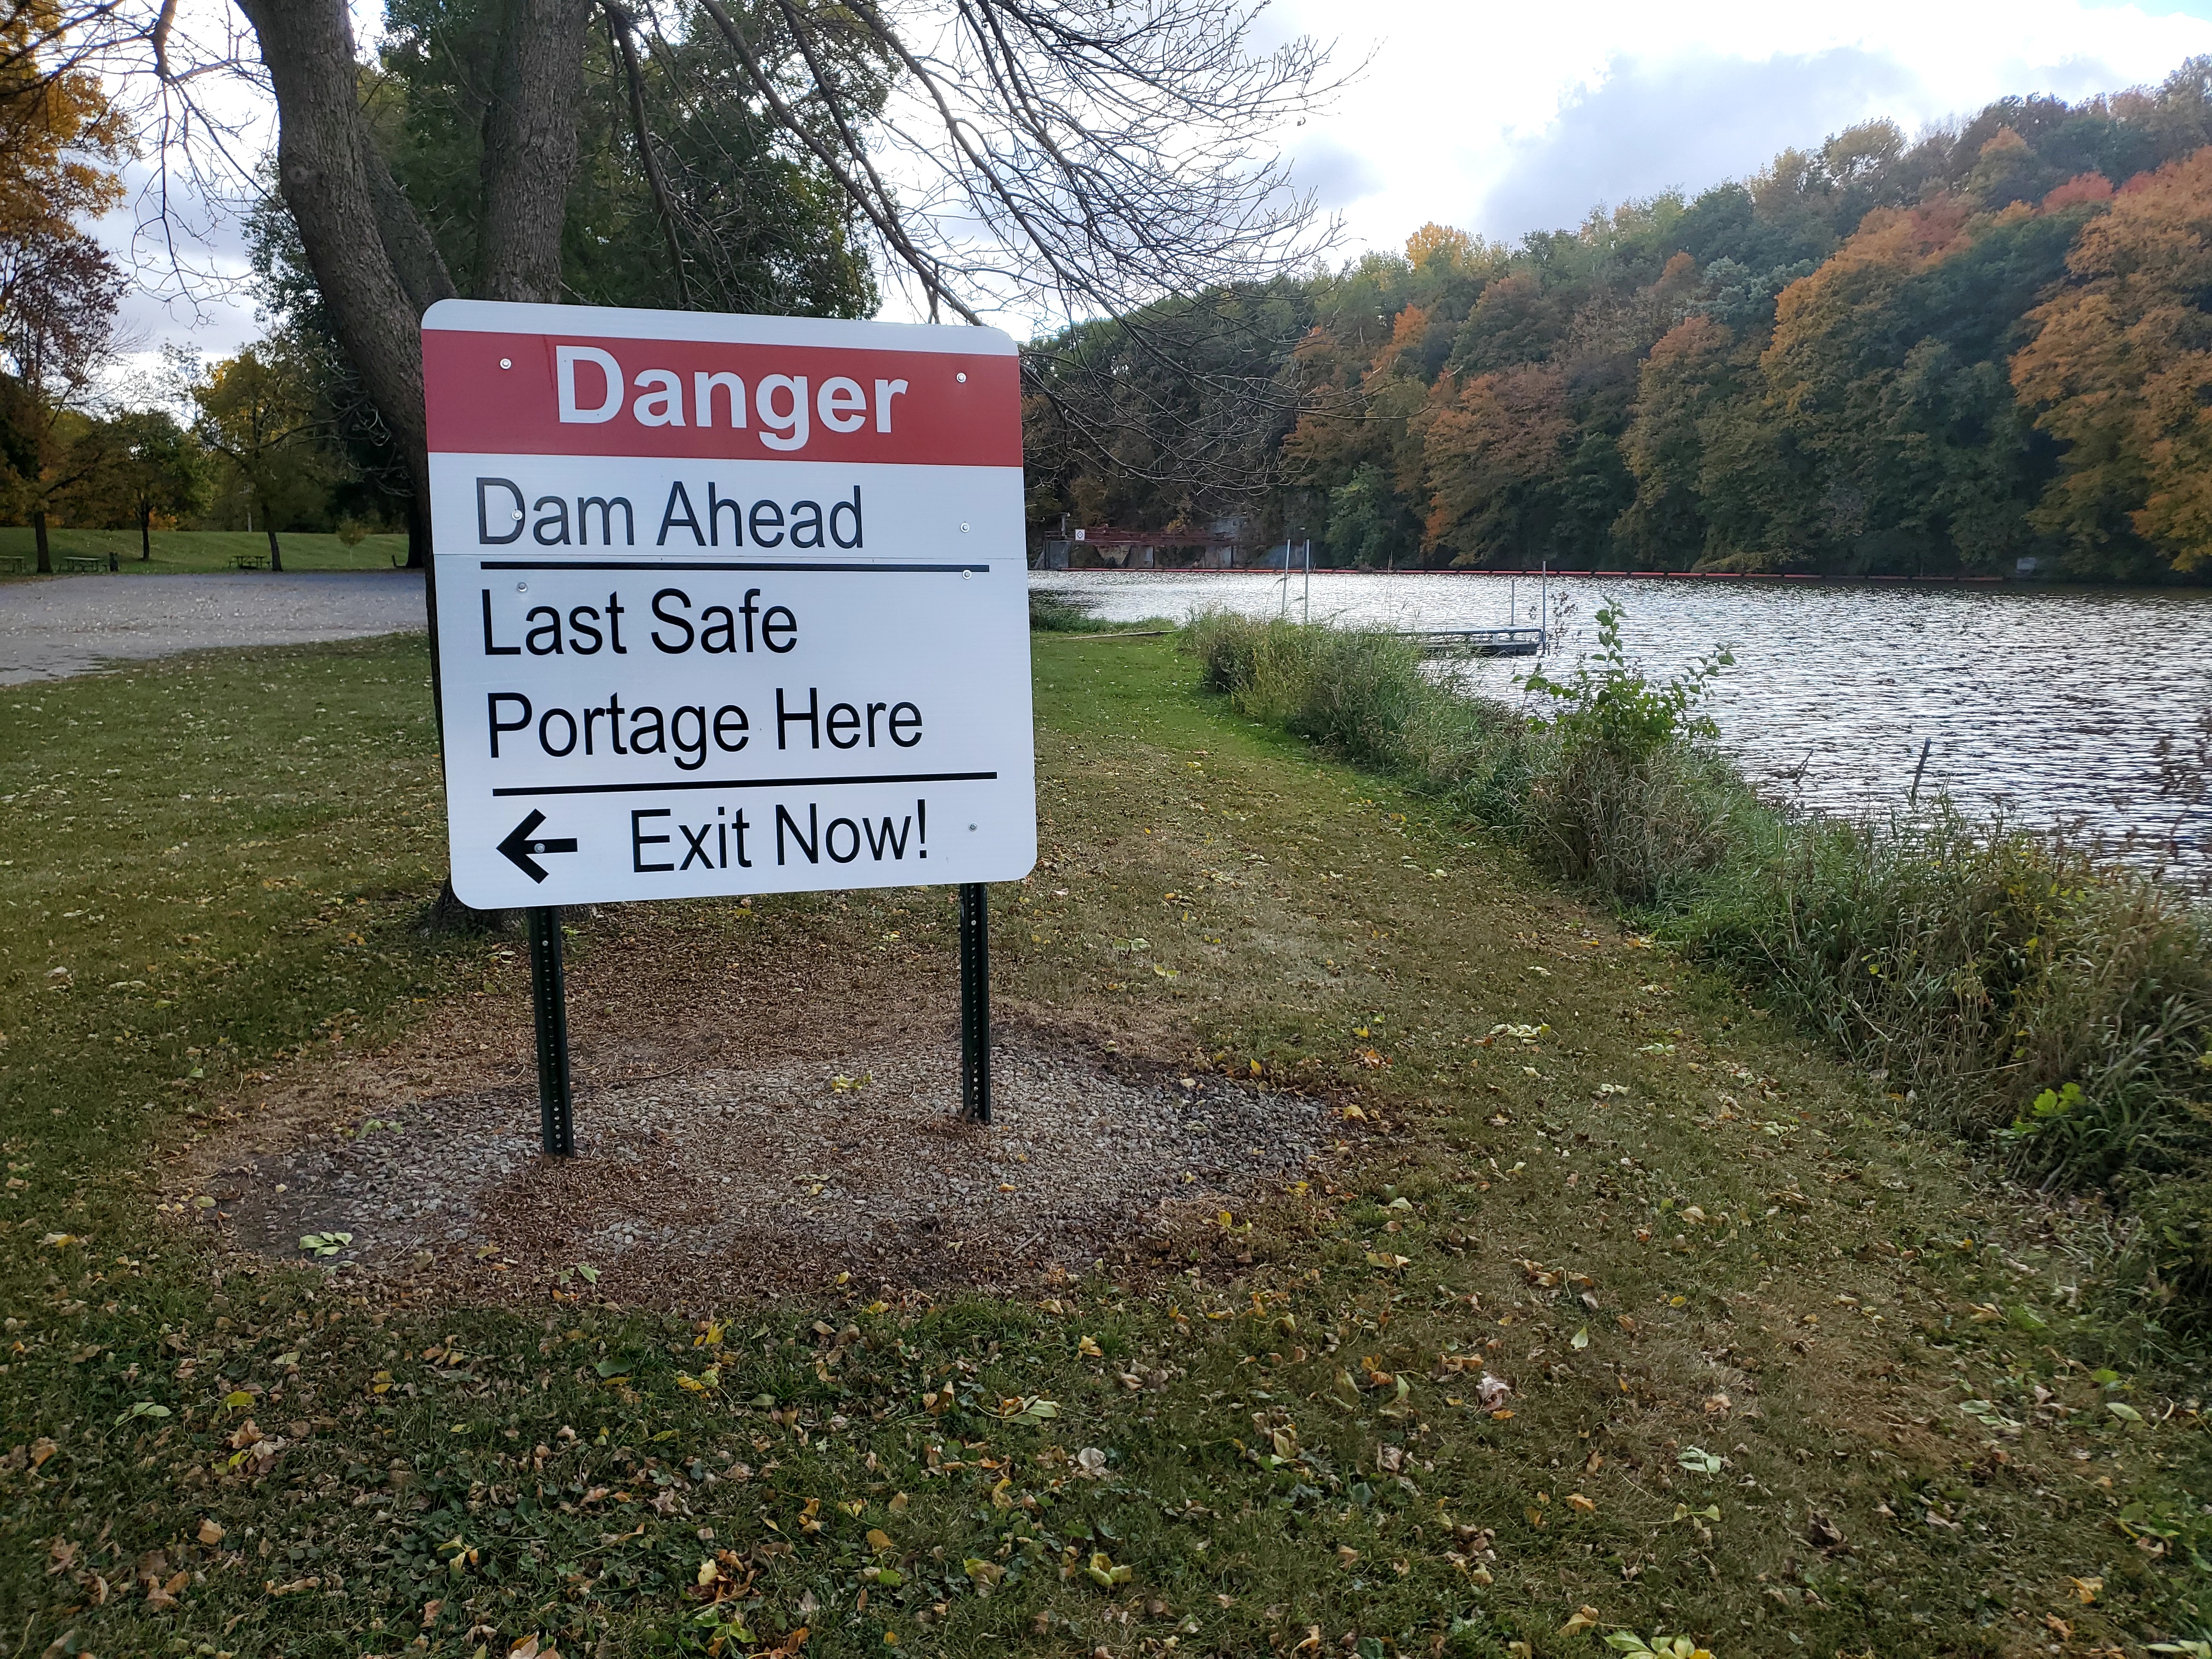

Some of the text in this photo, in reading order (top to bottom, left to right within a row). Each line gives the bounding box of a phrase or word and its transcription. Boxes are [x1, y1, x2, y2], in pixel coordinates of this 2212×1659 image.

[556, 345, 909, 451] Danger
[477, 478, 862, 549] Dam Ahead
[482, 588, 797, 655] Last Safe
[488, 688, 922, 770] Portage Here
[631, 799, 928, 872] Exit Now!
